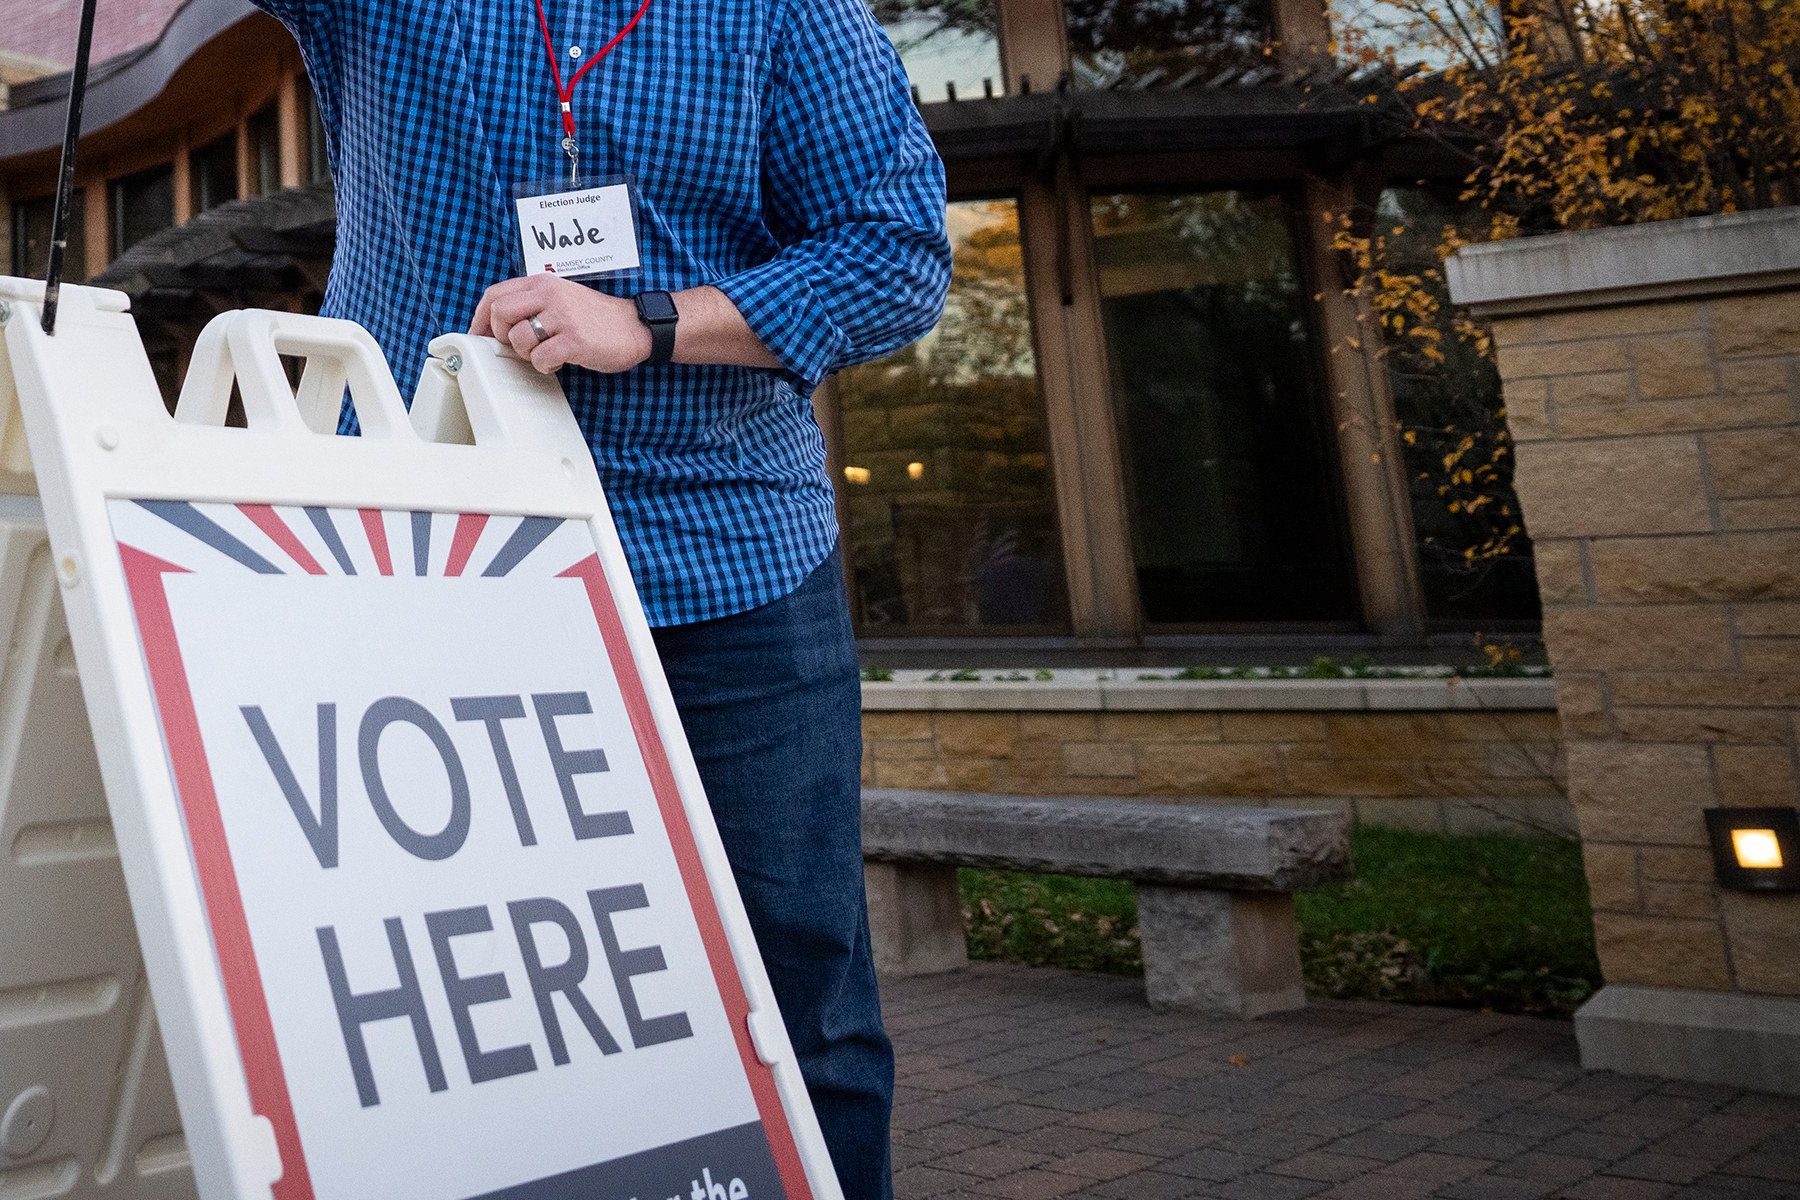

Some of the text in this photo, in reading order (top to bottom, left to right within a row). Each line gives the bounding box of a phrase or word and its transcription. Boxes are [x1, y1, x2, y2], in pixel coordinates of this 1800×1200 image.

[539, 194, 601, 208] Election Judge
[531, 218, 605, 250] Wade
[556, 255, 614, 267] RAMSEY COUNTY
[240, 691, 635, 869] VOTE
[315, 883, 694, 1108] HERE
